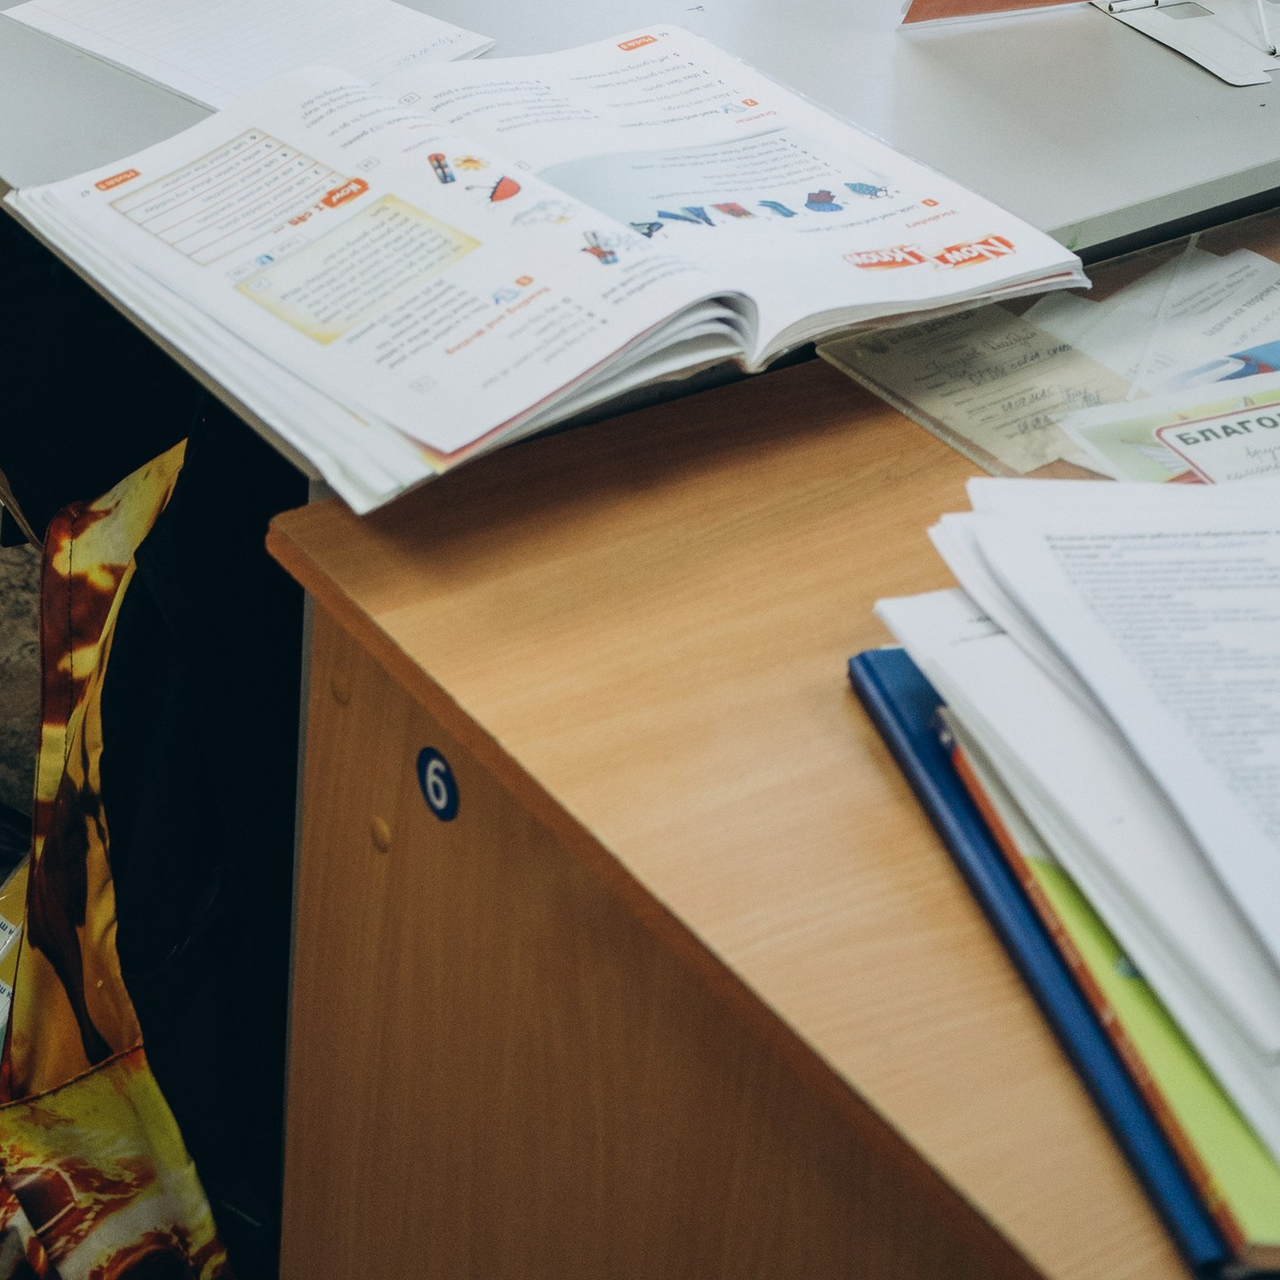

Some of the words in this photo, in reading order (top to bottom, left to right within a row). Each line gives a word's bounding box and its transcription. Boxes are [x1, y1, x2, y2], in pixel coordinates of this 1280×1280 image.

[331, 184, 361, 203] Now
[842, 245, 915, 266] know
[943, 238, 1012, 268] Now
[1175, 413, 1280, 446] БЛАГО
[425, 758, 448, 810] 6
